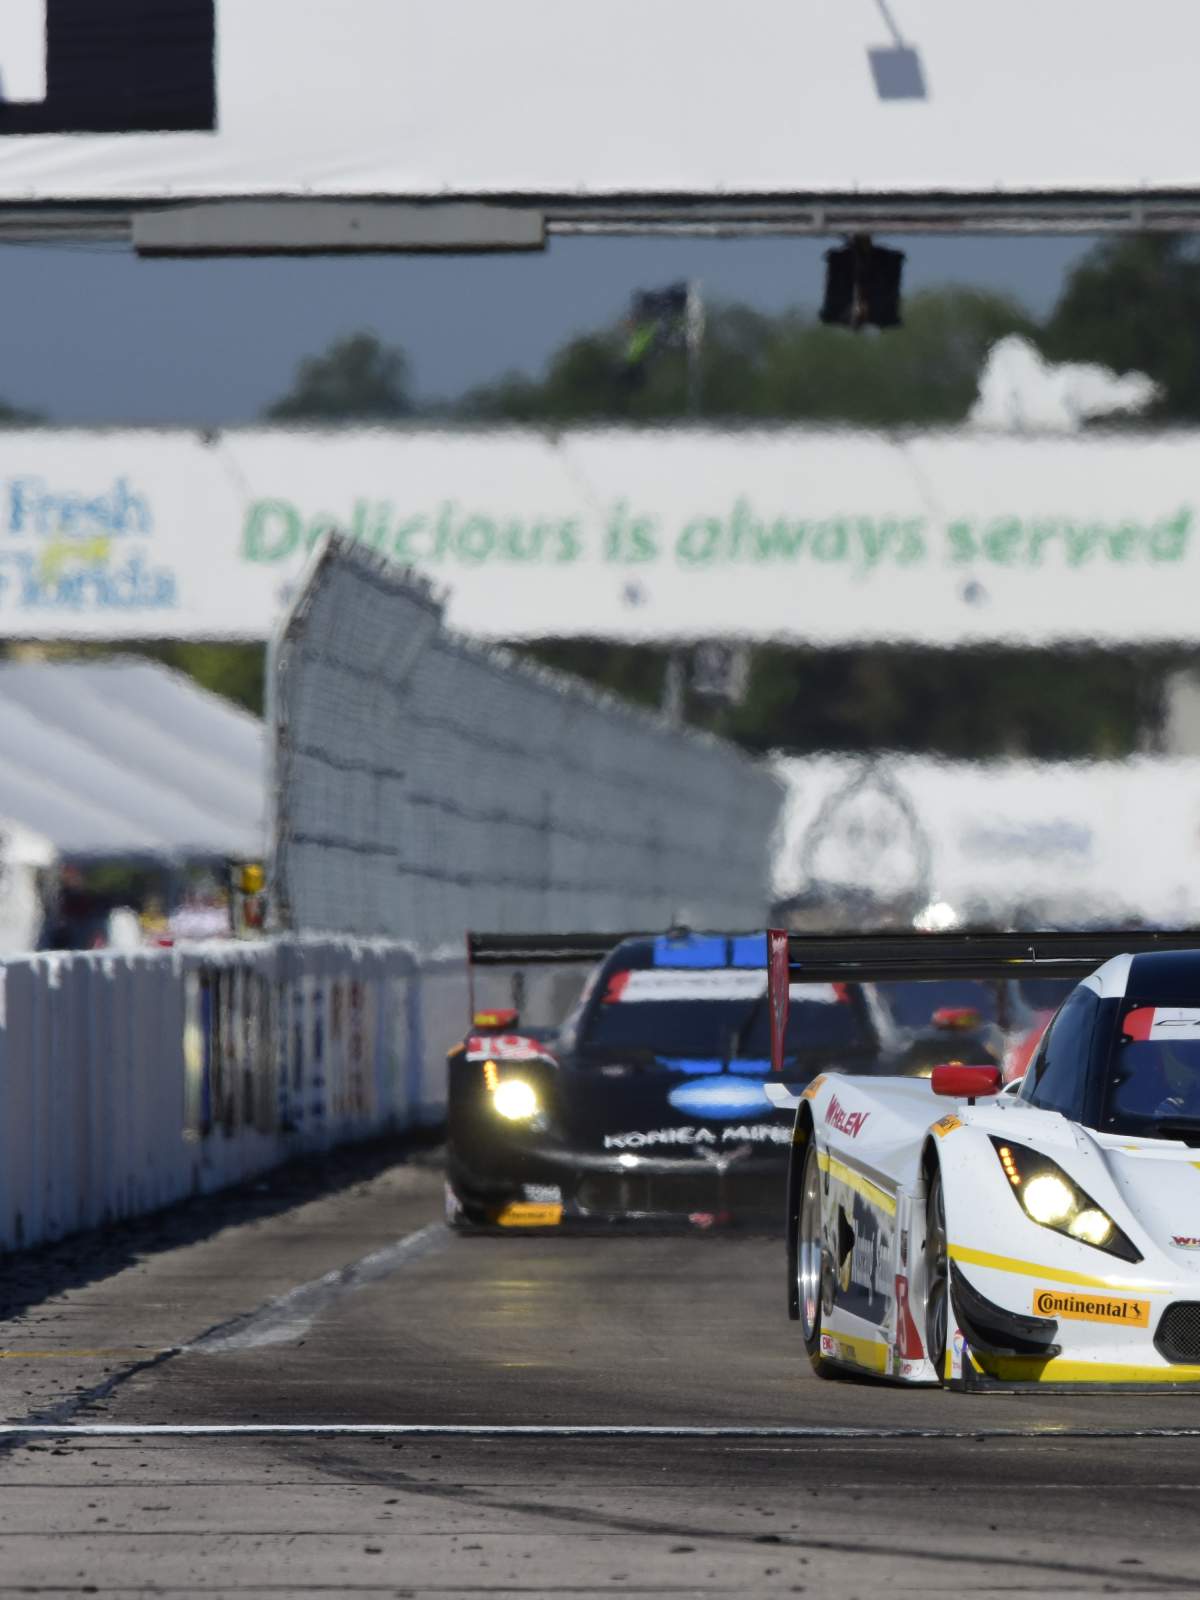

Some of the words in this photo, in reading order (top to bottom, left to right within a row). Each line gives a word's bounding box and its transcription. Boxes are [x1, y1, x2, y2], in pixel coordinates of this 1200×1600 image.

[606, 499, 660, 563] is
[675, 498, 928, 582] always
[948, 508, 1194, 566] served
[824, 1093, 872, 1138] WHELEN
[1037, 1292, 1128, 1319] Continental
